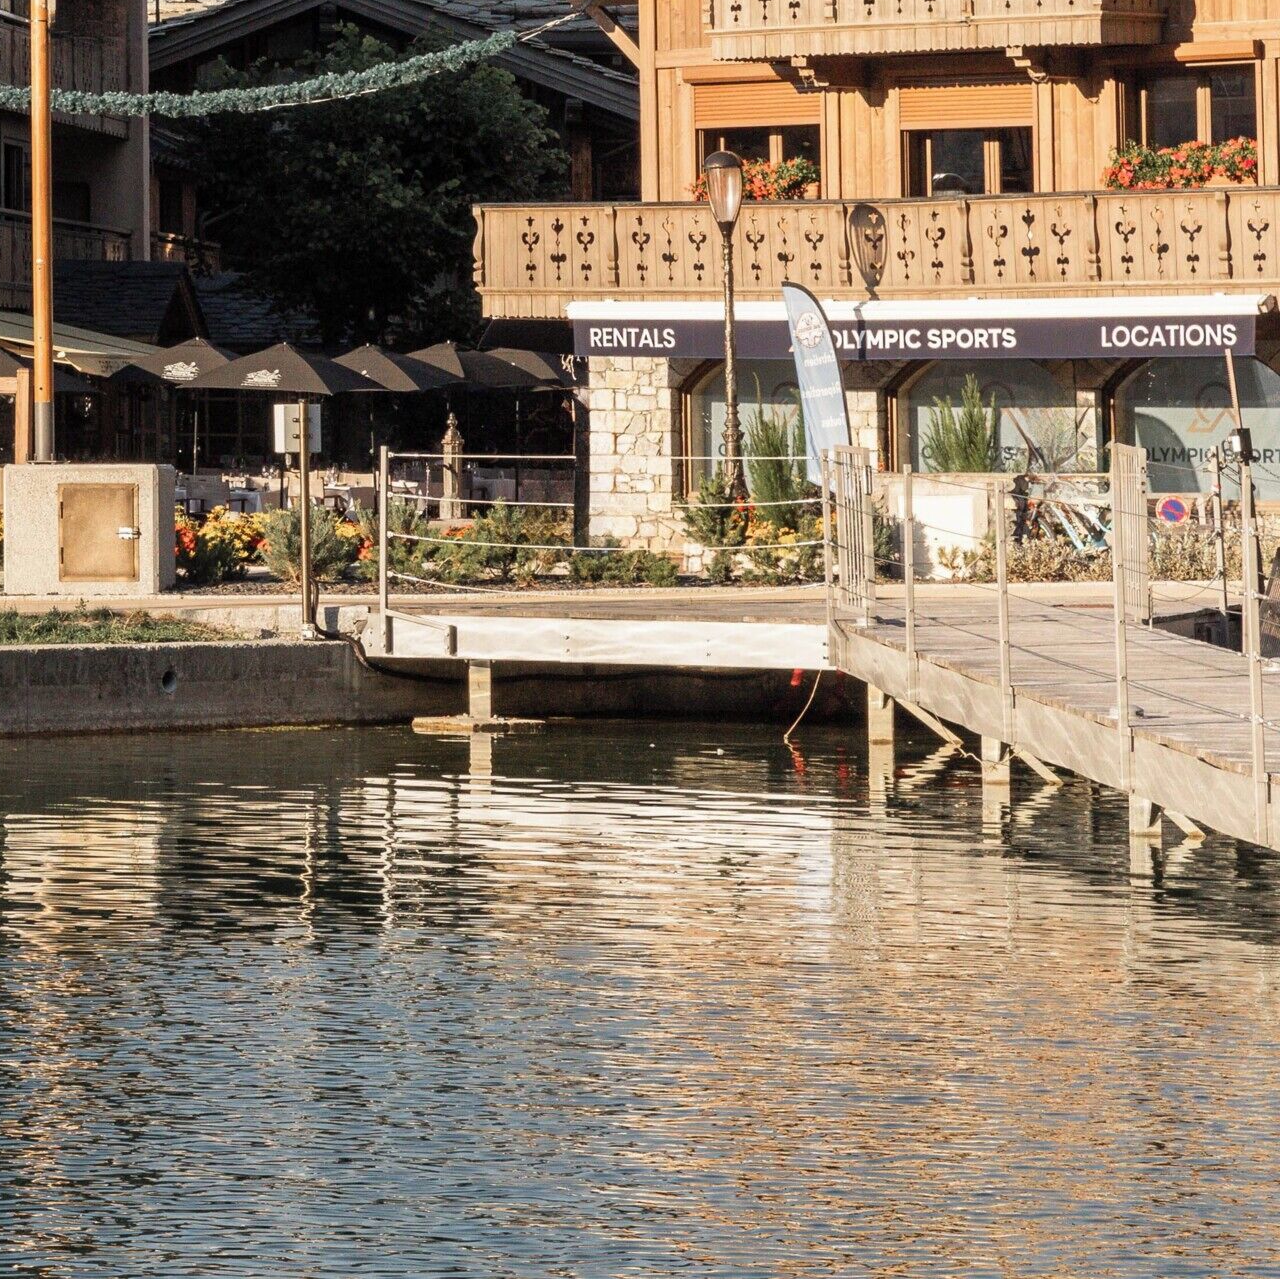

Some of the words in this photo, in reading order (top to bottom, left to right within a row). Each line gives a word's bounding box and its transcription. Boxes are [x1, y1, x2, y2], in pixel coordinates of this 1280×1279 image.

[590, 328, 676, 348] RENTALS
[927, 328, 1017, 349] SPORTS
[1101, 324, 1237, 348] LOCATIONS
